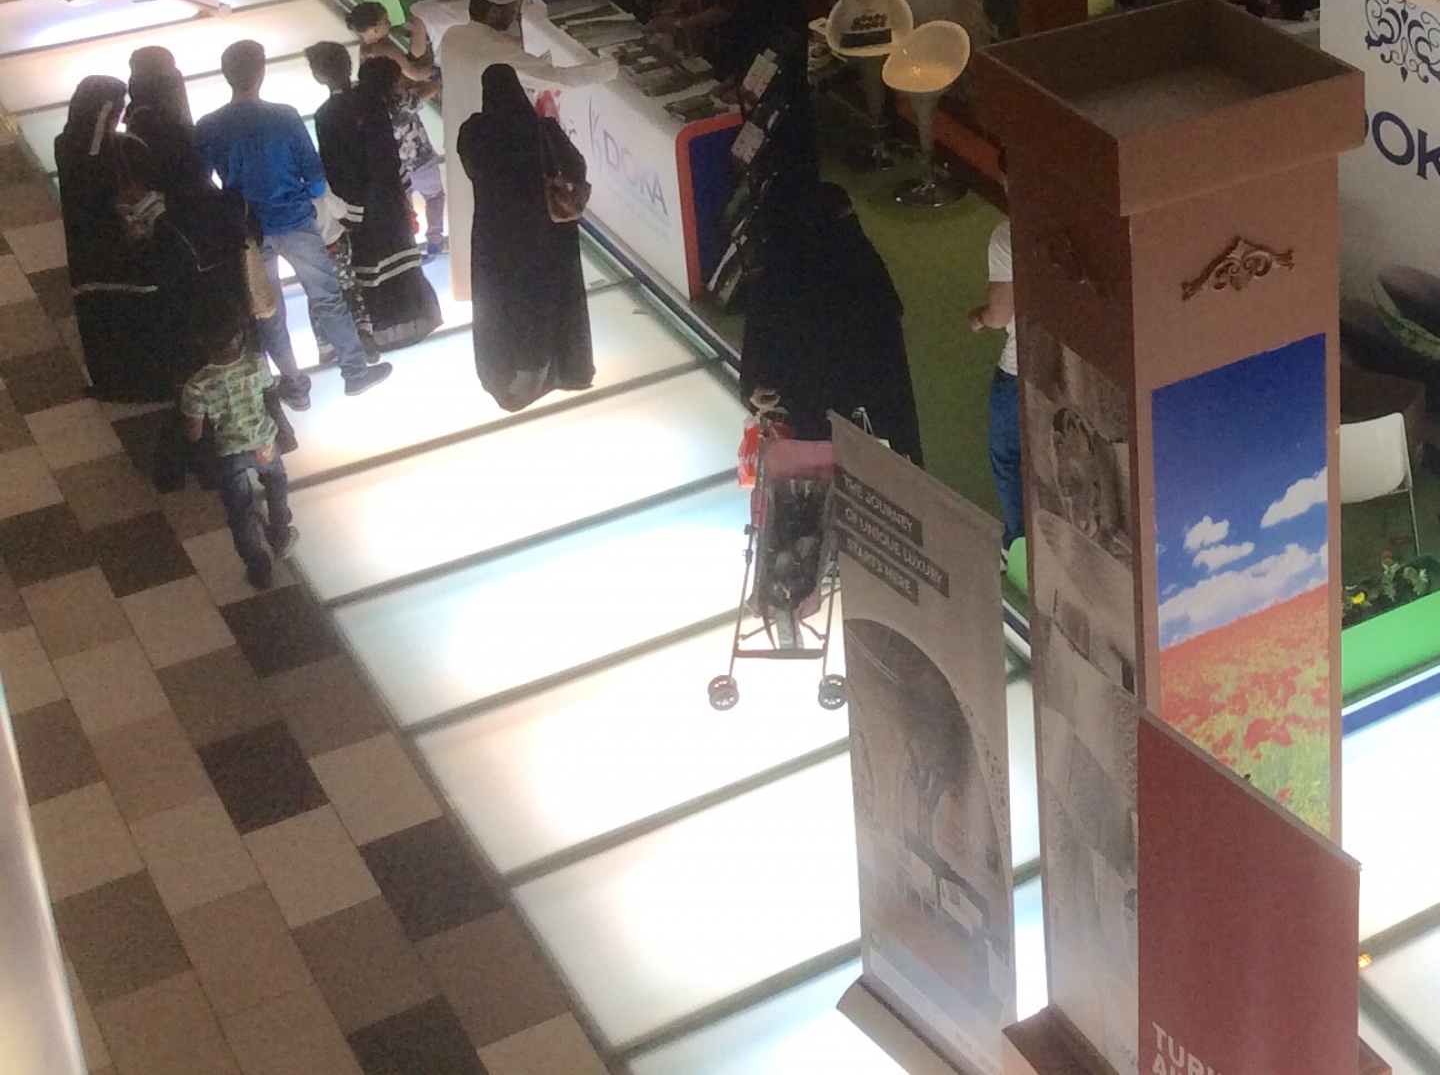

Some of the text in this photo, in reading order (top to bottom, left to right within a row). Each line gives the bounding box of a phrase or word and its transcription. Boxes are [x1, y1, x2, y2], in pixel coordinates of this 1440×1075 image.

[603, 129, 668, 216] DOKA
[865, 491, 914, 534] JOURNEY
[859, 518, 901, 557] UNIQUE
[902, 547, 944, 588] LUXURY
